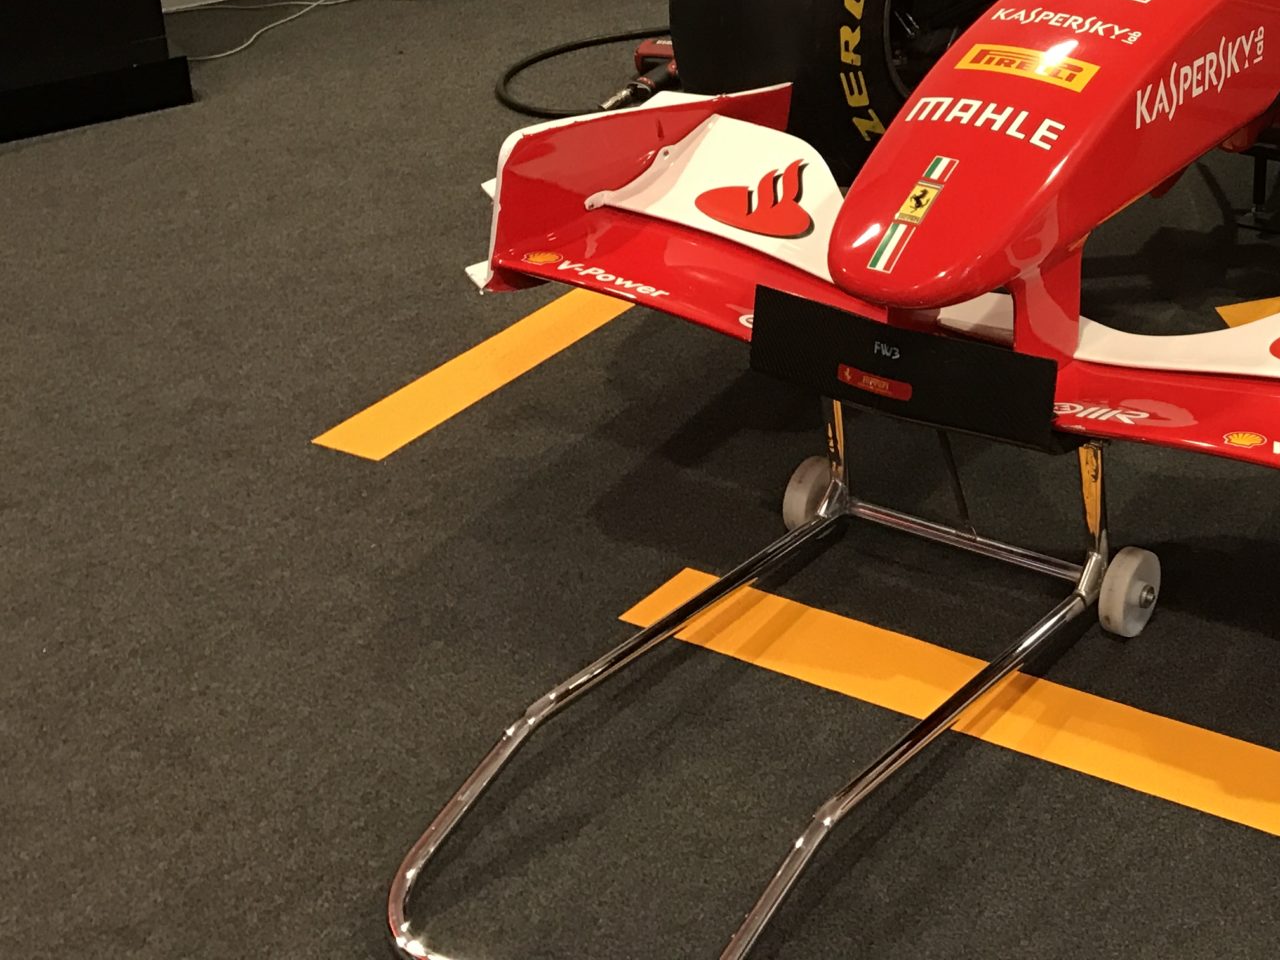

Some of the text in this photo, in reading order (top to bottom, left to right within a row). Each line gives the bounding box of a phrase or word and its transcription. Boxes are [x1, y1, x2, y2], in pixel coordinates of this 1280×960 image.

[991, 7, 1129, 43] KASPERSKY
[1135, 28, 1256, 130] KASPERSKY
[905, 96, 1066, 150] MAHLE
[557, 259, 670, 298] V-Power
